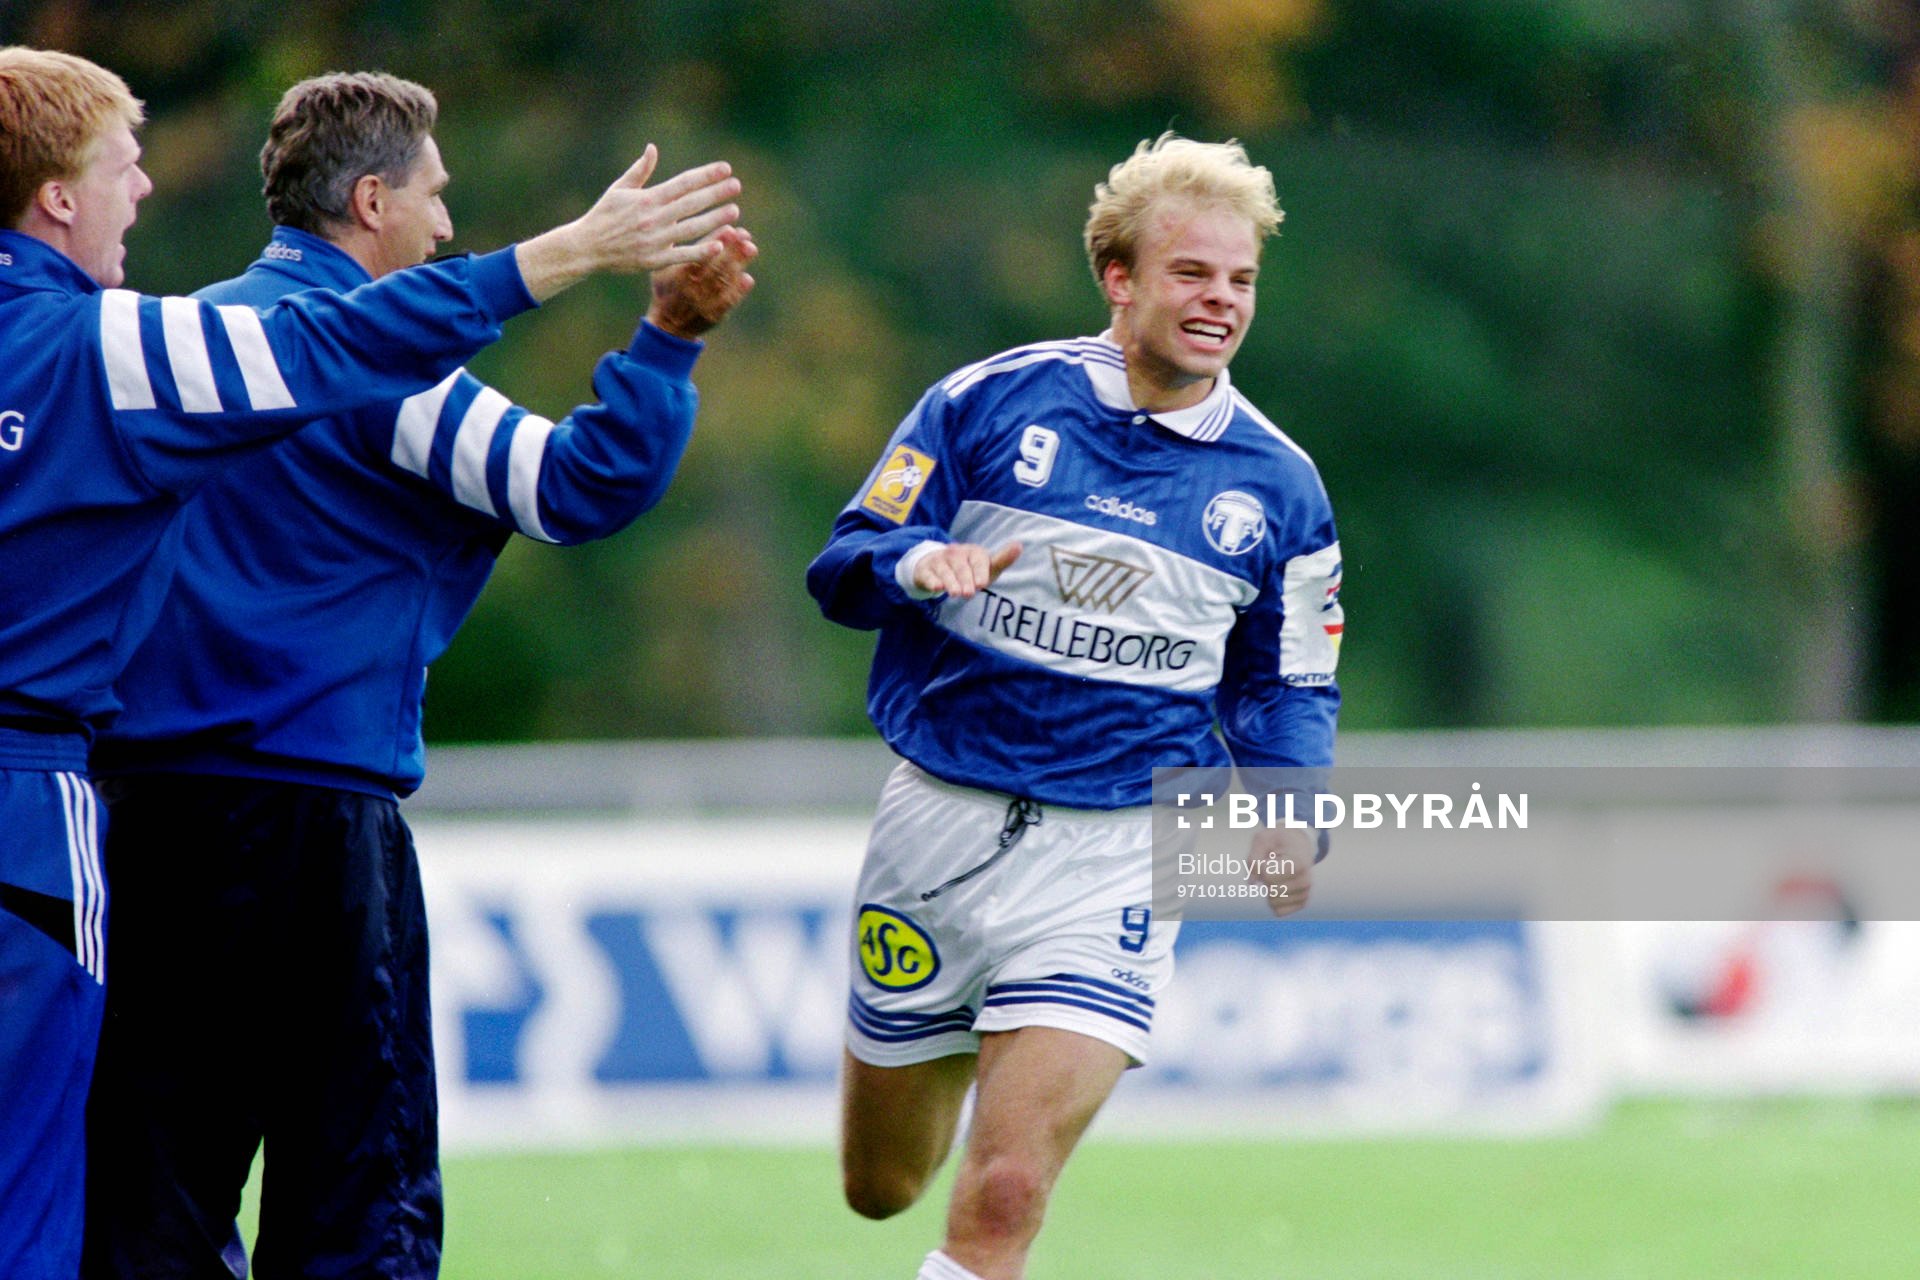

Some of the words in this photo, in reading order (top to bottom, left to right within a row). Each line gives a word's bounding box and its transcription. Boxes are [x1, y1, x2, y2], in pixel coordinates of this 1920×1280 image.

[0, 410, 25, 450] G
[1013, 425, 1060, 488] 9
[1084, 495, 1157, 526] adidas
[979, 588, 1197, 670] TRELLEBORG
[1119, 907, 1150, 953] 9
